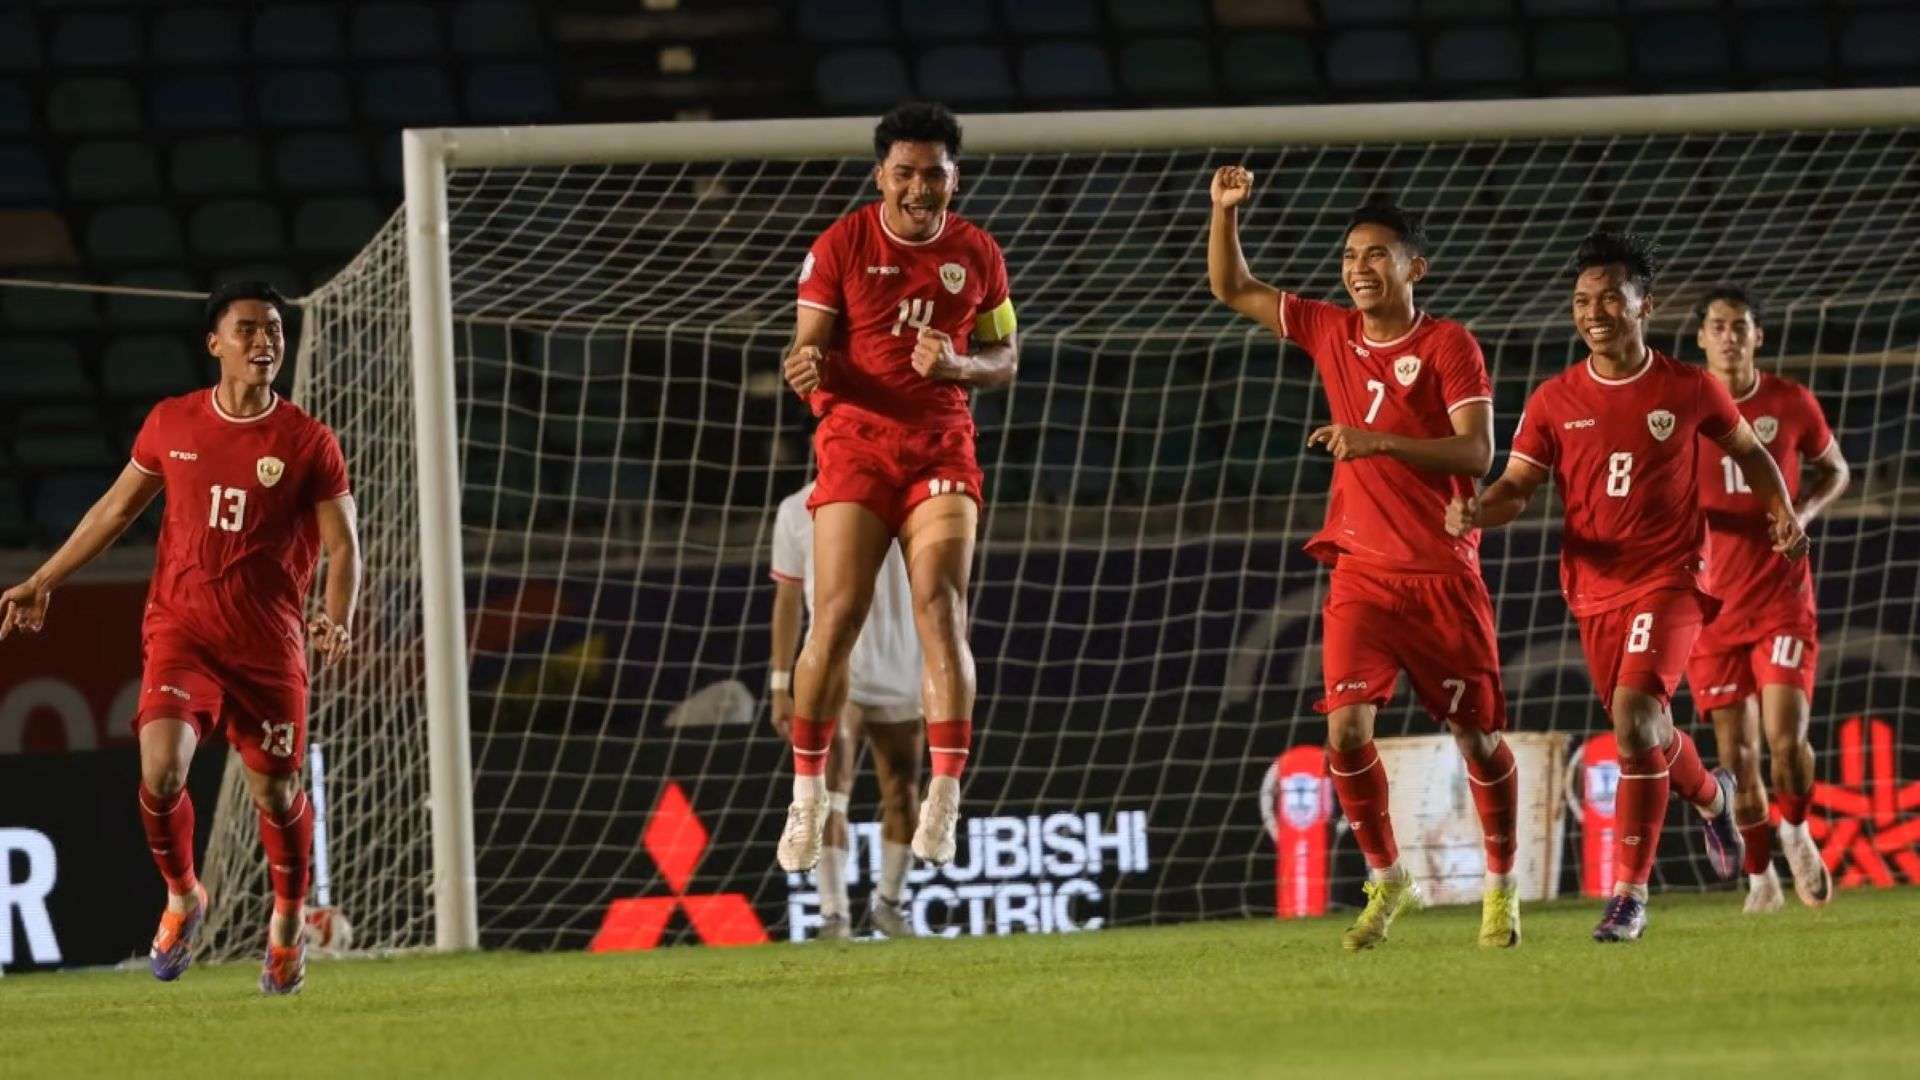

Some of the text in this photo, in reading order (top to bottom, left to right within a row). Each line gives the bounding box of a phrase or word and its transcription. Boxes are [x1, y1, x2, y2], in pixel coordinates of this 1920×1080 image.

[1364, 379, 1385, 424] 7
[1606, 452, 1633, 497] 8
[208, 485, 248, 532] 13
[1627, 612, 1654, 654] 8
[1770, 635, 1805, 669] 10
[1442, 678, 1467, 714] 7
[260, 719, 296, 758] 13
